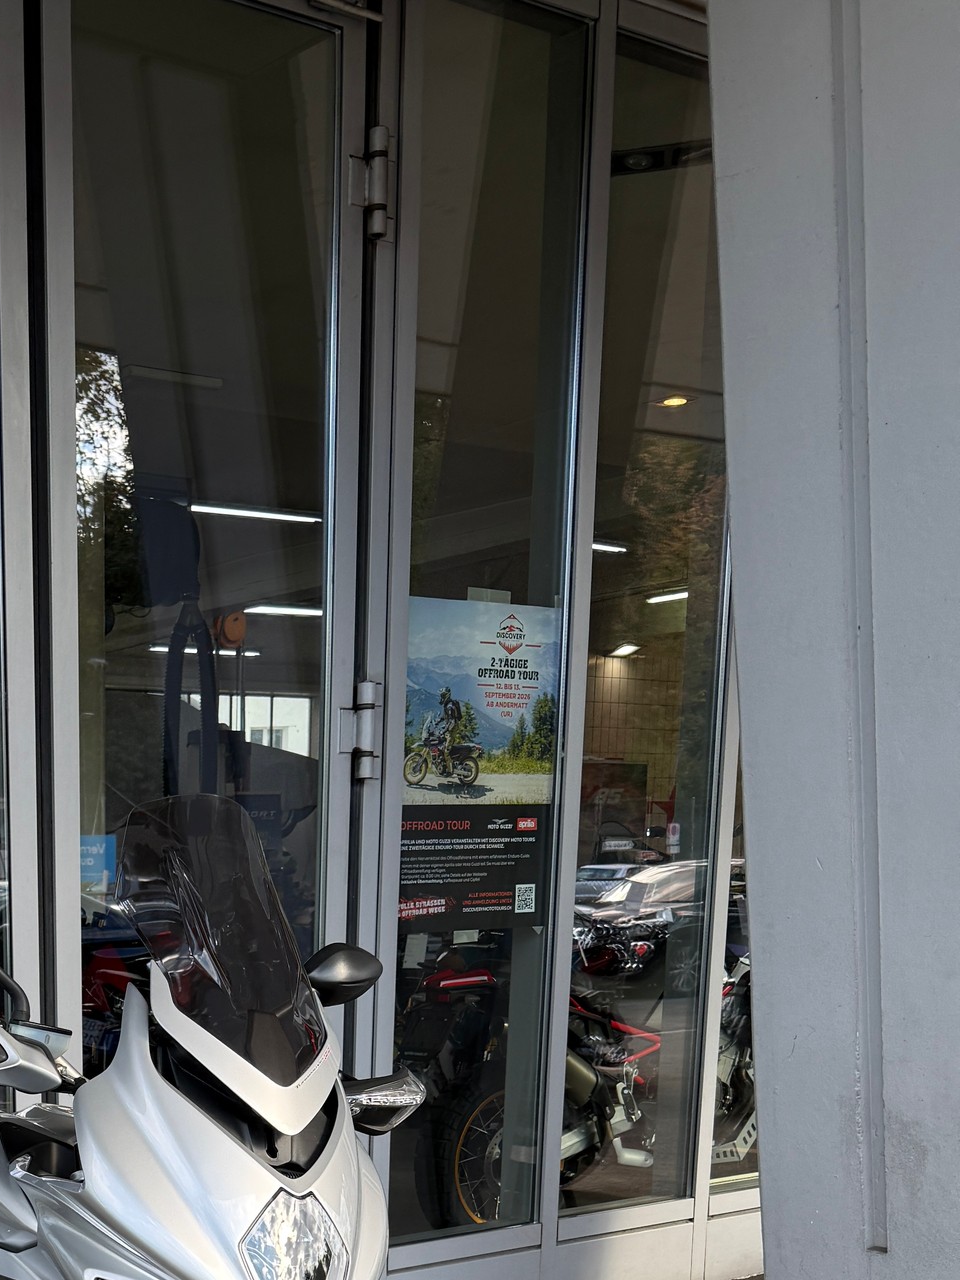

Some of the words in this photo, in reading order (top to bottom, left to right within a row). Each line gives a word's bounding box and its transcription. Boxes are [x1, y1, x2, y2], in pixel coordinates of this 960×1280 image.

[478, 668, 516, 679] OFFROAD
[518, 670, 539, 681] TOUR
[484, 692, 516, 700] SEPTEMBER
[401, 820, 444, 830] OFFROAD
[446, 820, 471, 830] TOUR
[518, 820, 534, 828] aprilia
